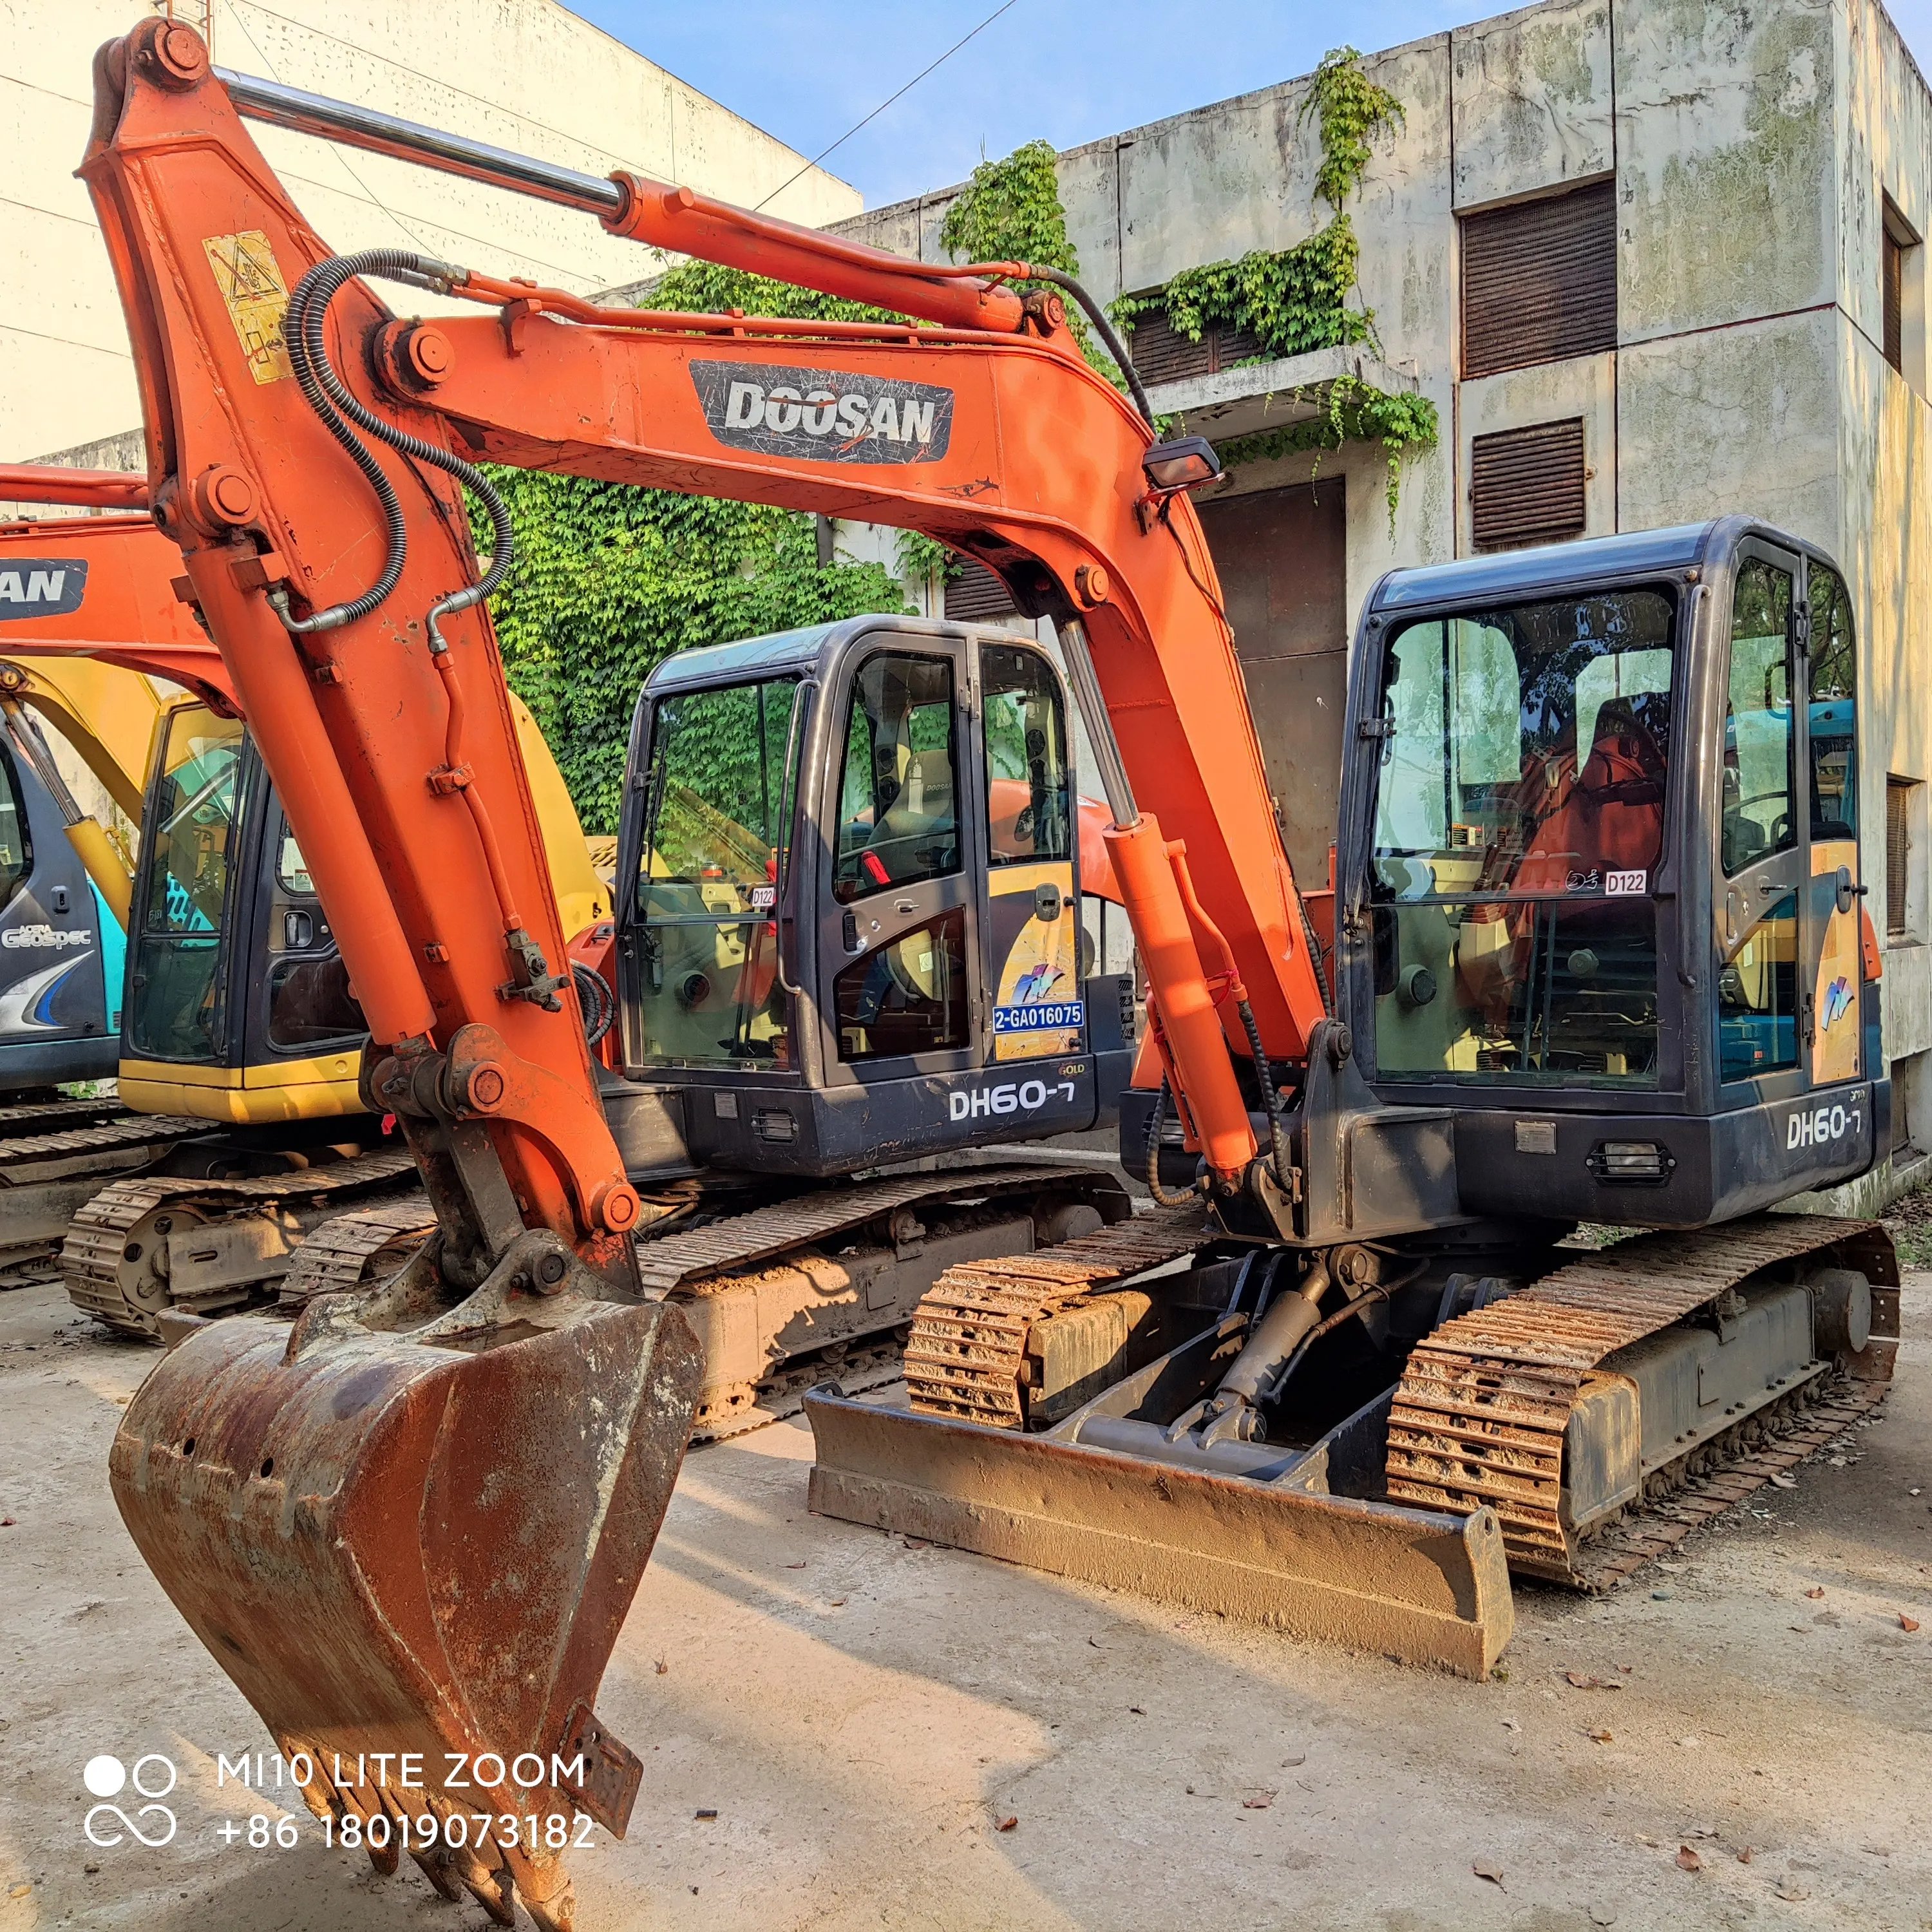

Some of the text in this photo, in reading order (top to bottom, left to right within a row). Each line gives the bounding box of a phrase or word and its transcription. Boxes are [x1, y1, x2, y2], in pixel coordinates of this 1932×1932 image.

[725, 380, 935, 444] DOOSAN
[753, 890, 773, 904] D122
[1608, 874, 1643, 893] D122
[995, 1005, 1081, 1029] 2-GA016075
[949, 1080, 1075, 1121] DH60-7
[1787, 1104, 1861, 1150] DH60-7
